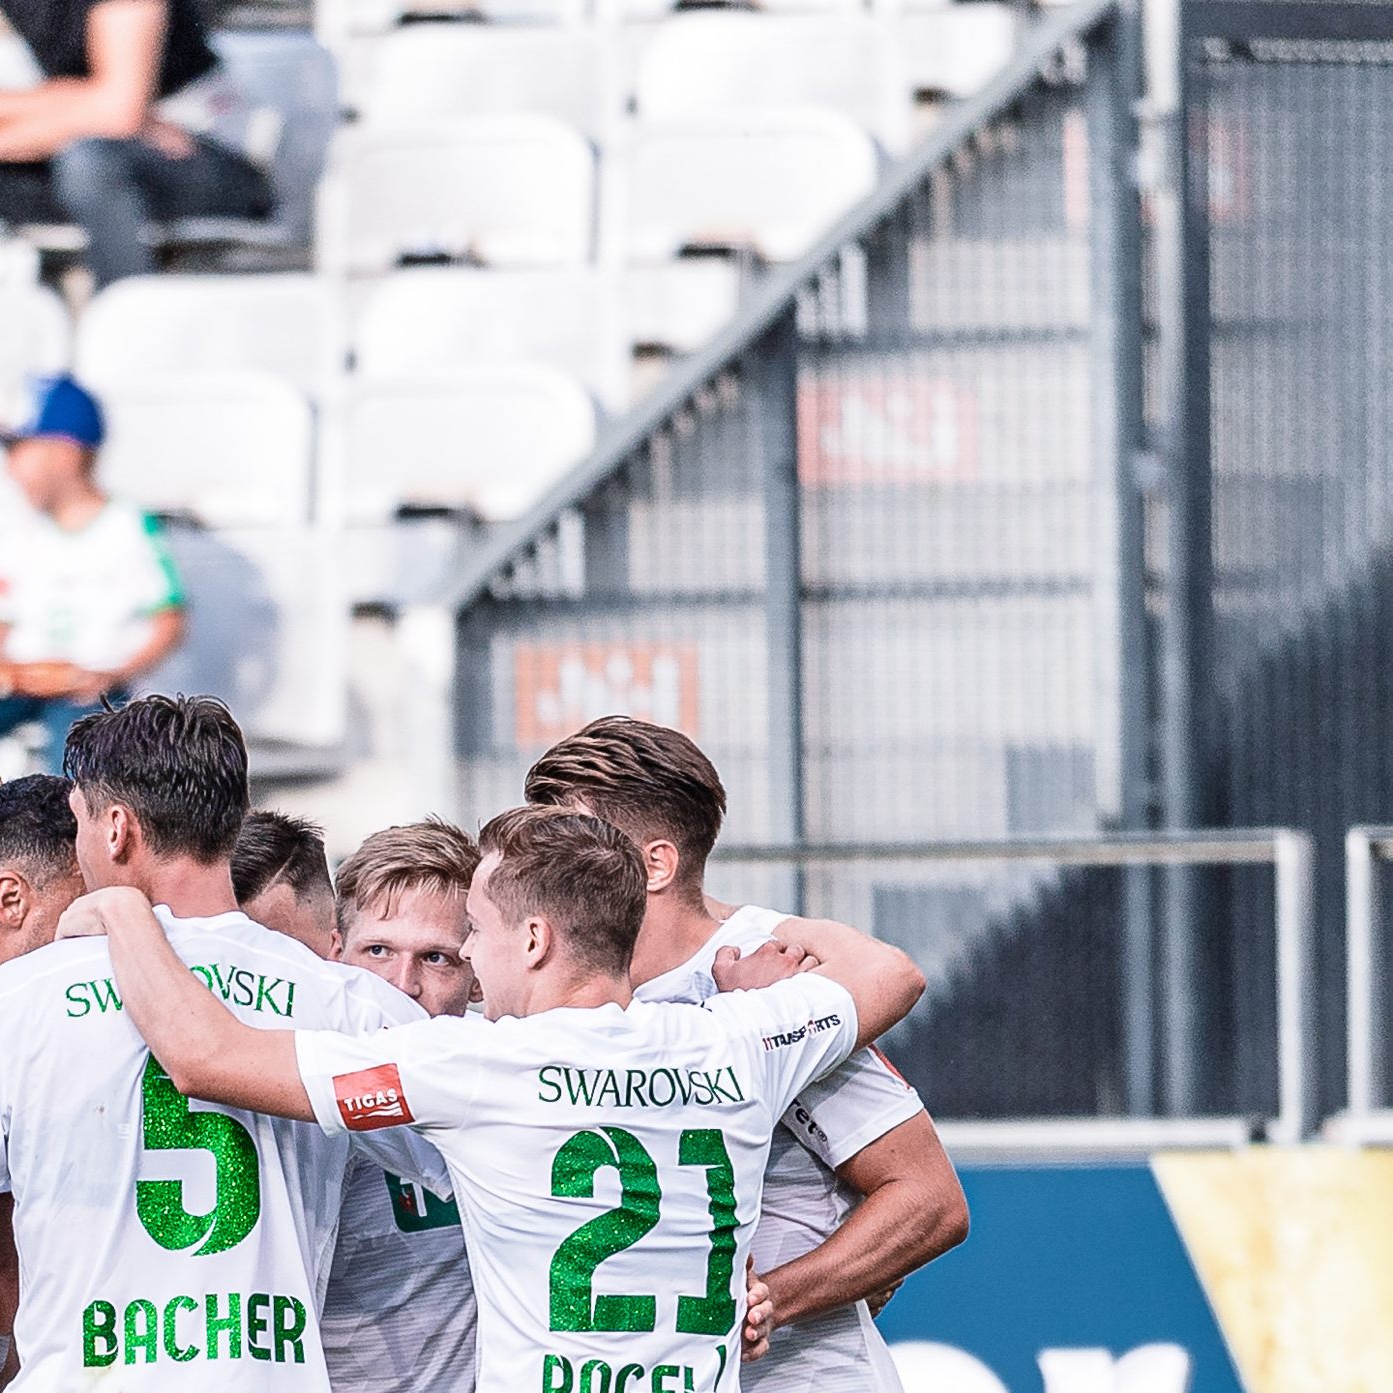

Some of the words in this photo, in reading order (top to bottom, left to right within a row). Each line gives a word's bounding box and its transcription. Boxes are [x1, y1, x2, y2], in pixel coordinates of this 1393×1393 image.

[344, 1088, 398, 1112] TIGAS
[538, 1065, 745, 1107] SWAROVSKI
[136, 1048, 261, 1257] 5
[549, 1126, 741, 1336] 21
[83, 1293, 307, 1367] BACHER
